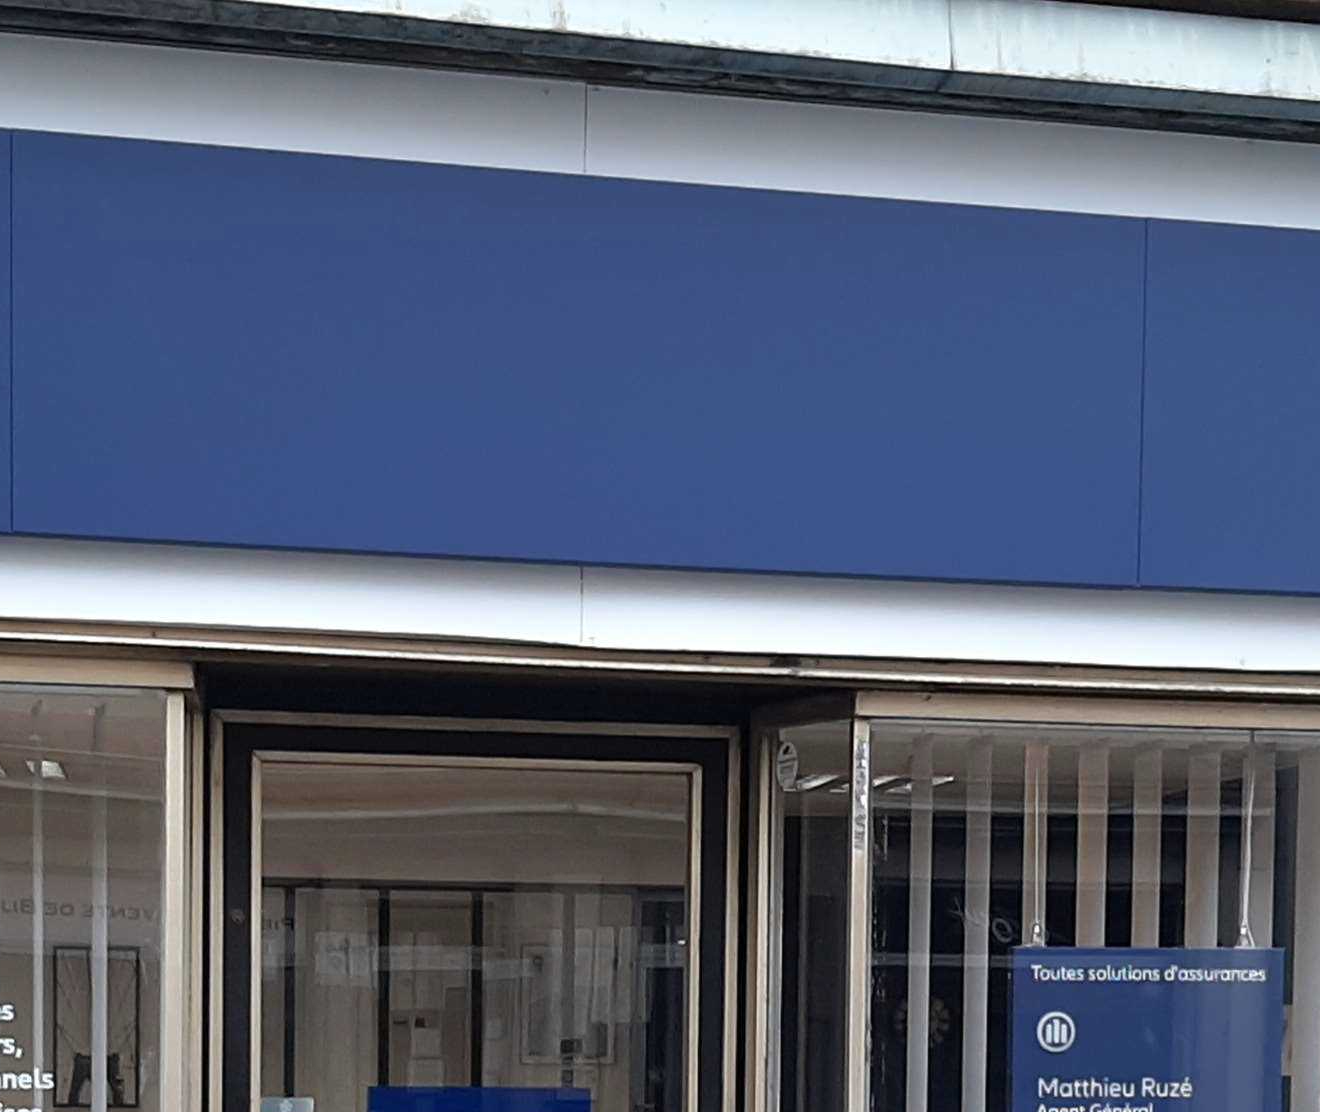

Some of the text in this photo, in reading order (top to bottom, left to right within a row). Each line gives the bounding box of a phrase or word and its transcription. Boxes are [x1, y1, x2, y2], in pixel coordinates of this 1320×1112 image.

[1031, 963, 1267, 983] Toutes solutions d'assurances
[1037, 1076, 1194, 1098] Matthieu Ruzé
